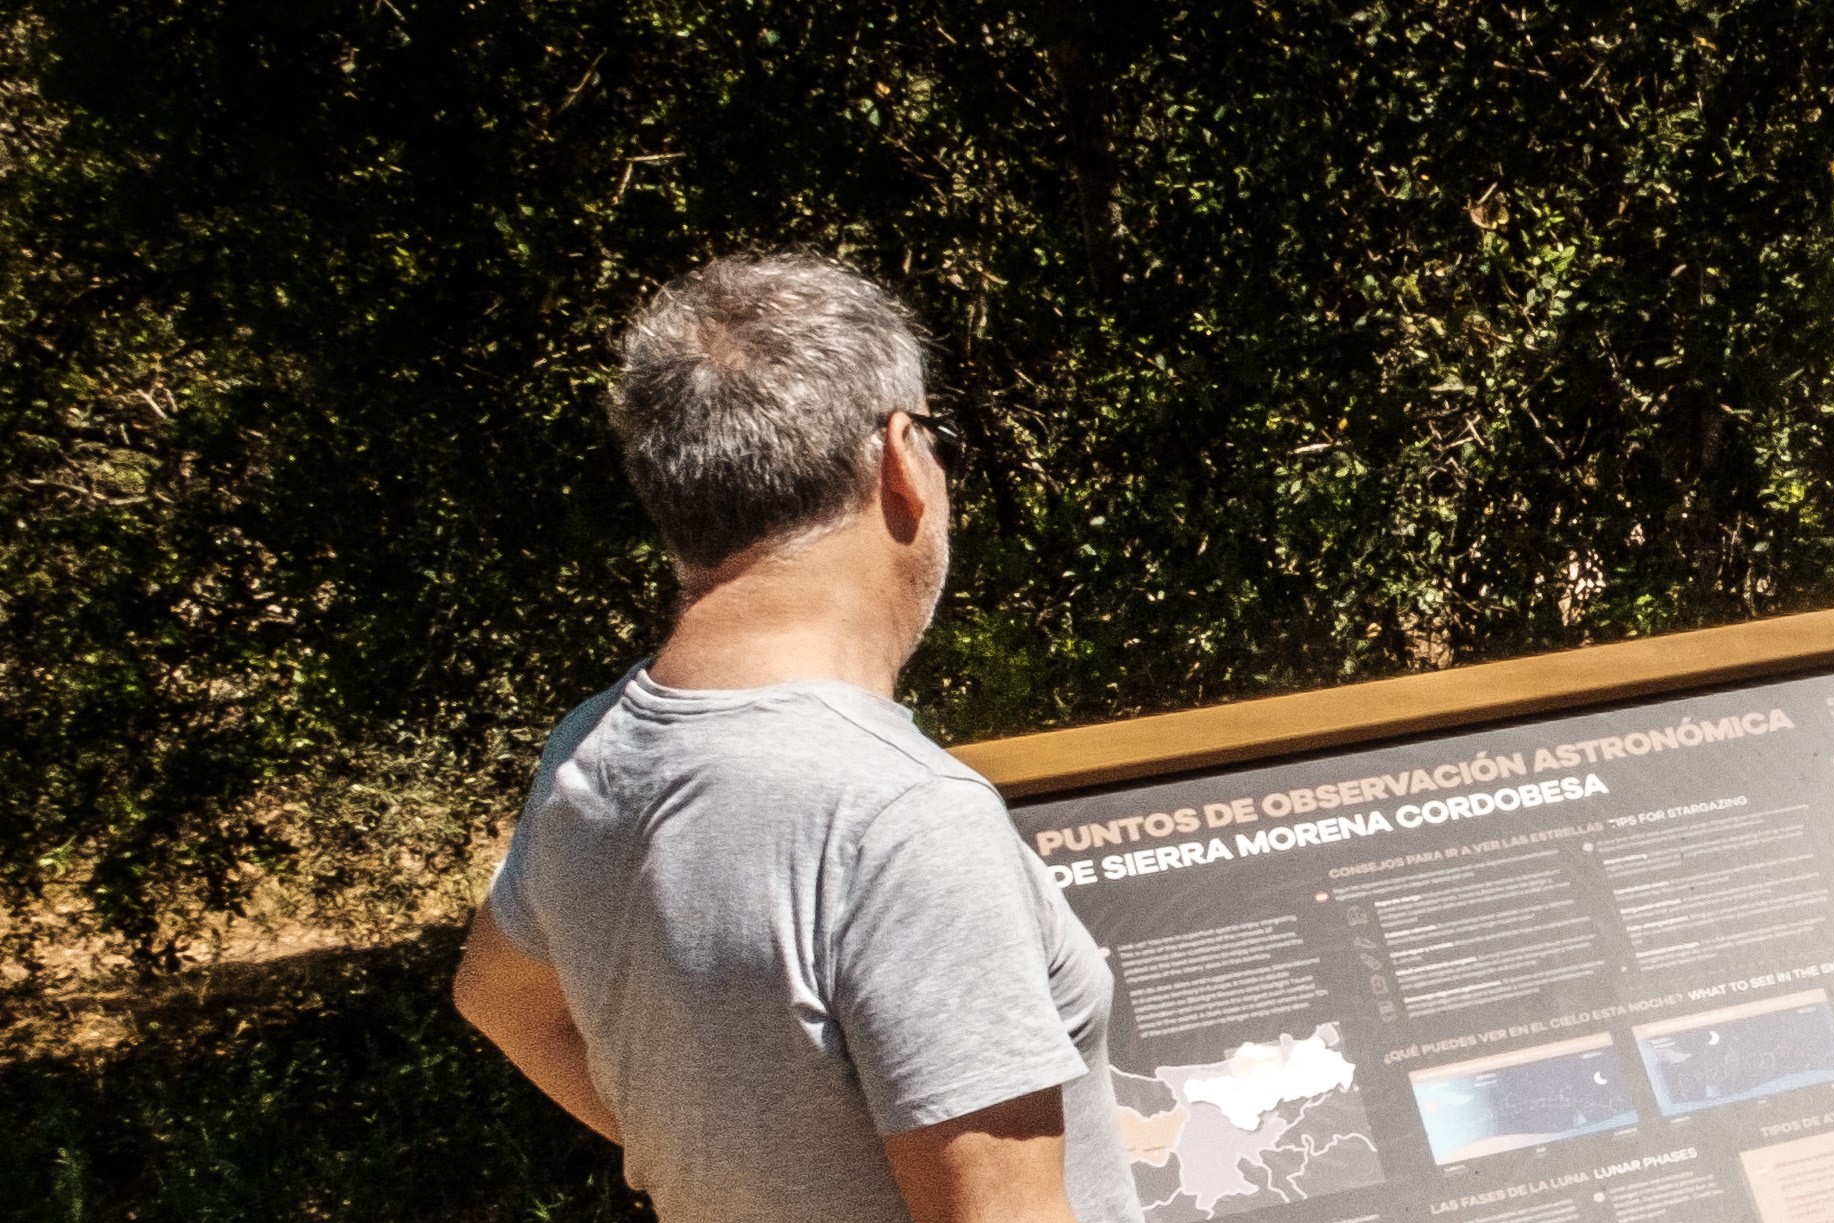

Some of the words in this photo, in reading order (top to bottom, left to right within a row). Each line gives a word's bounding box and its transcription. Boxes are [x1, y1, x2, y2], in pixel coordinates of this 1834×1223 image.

[1036, 807, 1201, 857] PUNTOS
[1204, 799, 1258, 829] DE
[1262, 751, 1527, 818] OBSERVACIÓN
[1533, 708, 1795, 773] ASTRONÓMICA
[1047, 859, 1098, 889] DE
[1102, 839, 1231, 880] SIERRA
[1236, 810, 1392, 858] MORENA
[1395, 773, 1609, 828] CORDOBESA
[1639, 808, 1666, 824] FOR
[1667, 795, 1749, 820] STARGAZING
[1328, 857, 1404, 880] CONSEJOS
[1405, 848, 1443, 866] PARA
[1444, 846, 1458, 859] IR
[1460, 843, 1472, 856] A
[1473, 839, 1499, 855] VER
[1502, 834, 1529, 848] LAS
[1529, 821, 1604, 844] ESTRELLAS
[1688, 980, 1726, 1001] WHAT
[1728, 976, 1749, 991] TO
[1750, 972, 1776, 989] SEE
[1776, 969, 1790, 983] IN
[1790, 964, 1818, 981] THE
[1384, 1045, 1421, 1066] ¿QUÉ
[1422, 1034, 1477, 1055] PUEDES
[1478, 1028, 1508, 1044] VER
[1509, 1024, 1529, 1038] EN
[1530, 1020, 1548, 1033] EL
[1549, 1011, 1591, 1029] CIELO
[1592, 1005, 1627, 1021] ESTA
[1628, 993, 1683, 1014] NOCHE?
[1760, 1120, 1801, 1138] TIPOS
[1803, 1116, 1822, 1129] DE
[1593, 1160, 1642, 1180] LUNAR
[1643, 1146, 1698, 1167] PHASES
[1430, 1199, 1459, 1215] LAS
[1461, 1189, 1507, 1208] FASES
[1508, 1184, 1528, 1199] DE
[1529, 1180, 1550, 1194] LA
[1551, 1171, 1590, 1189] LUNA
